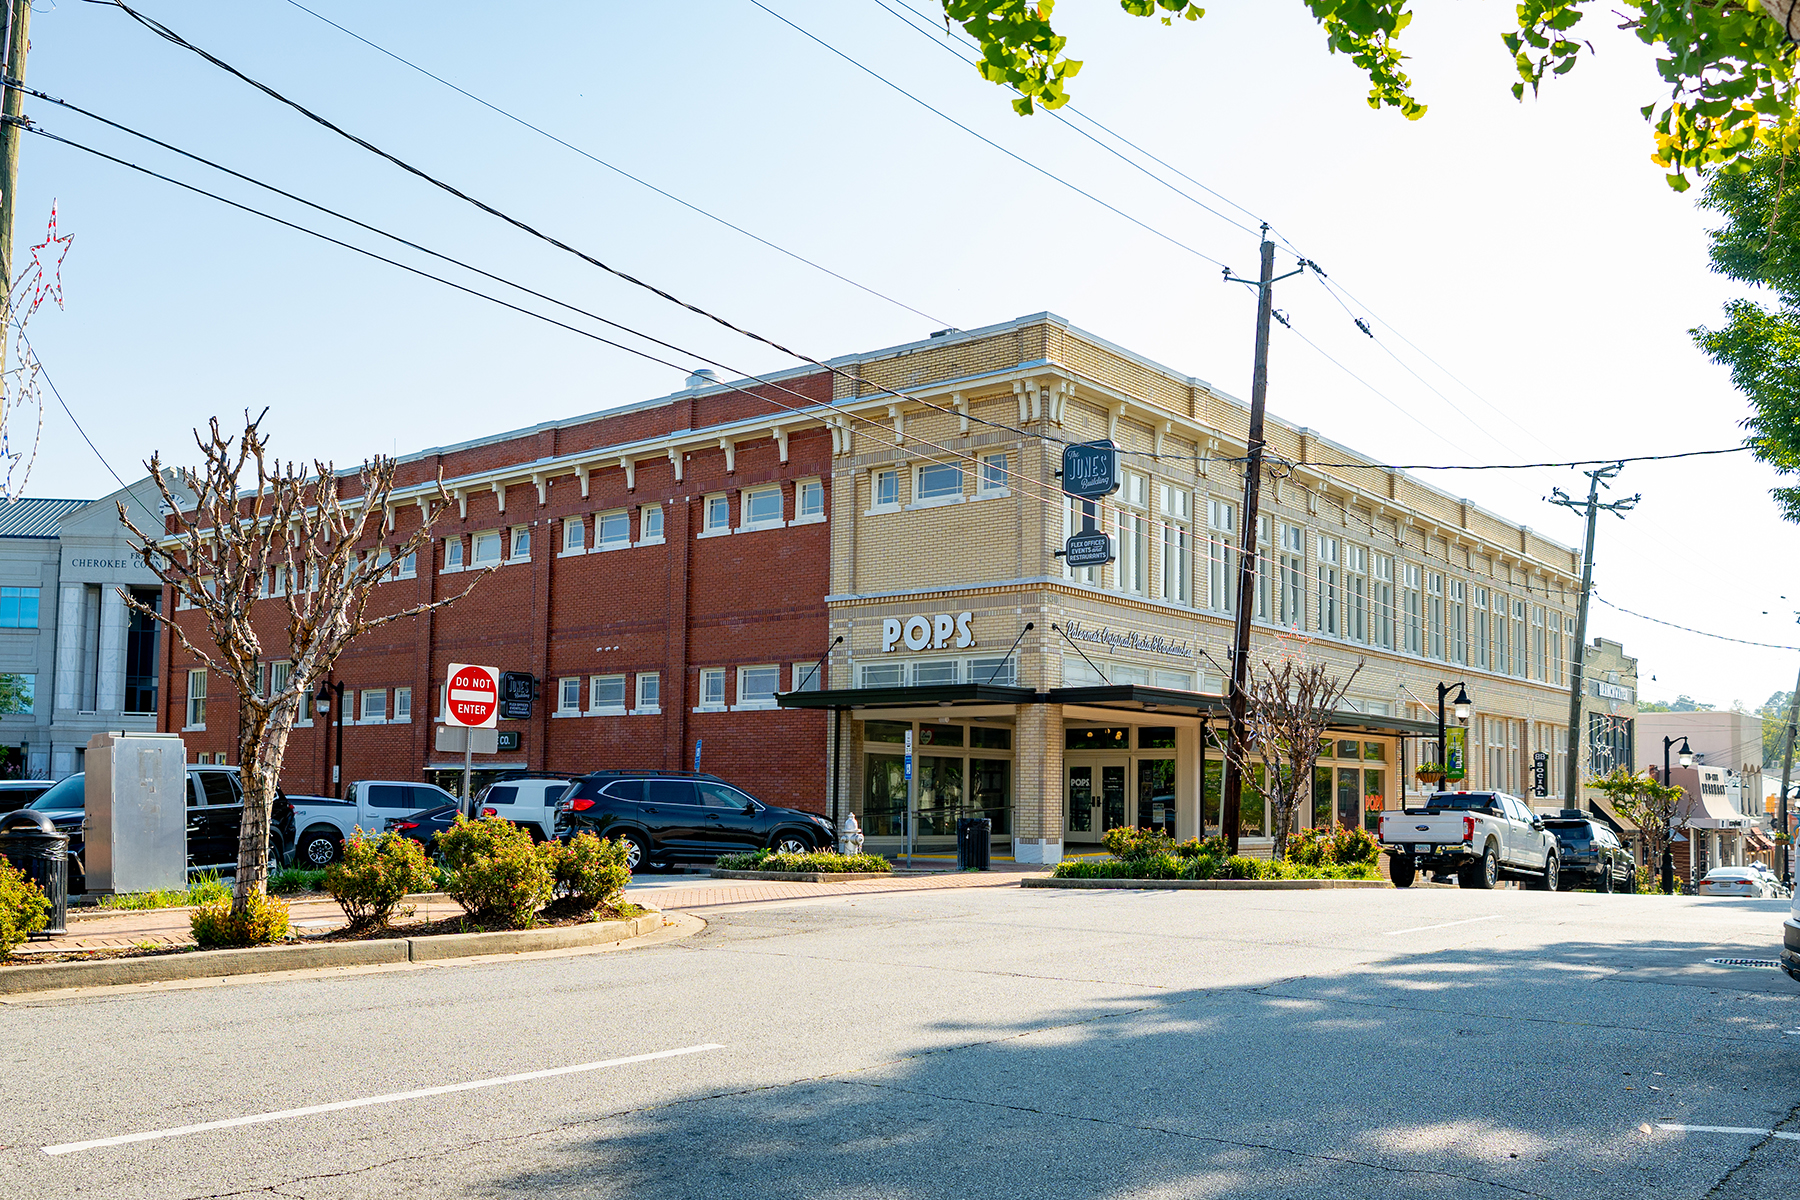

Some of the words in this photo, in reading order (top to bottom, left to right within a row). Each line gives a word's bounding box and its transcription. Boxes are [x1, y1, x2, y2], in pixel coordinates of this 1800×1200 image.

[1069, 454, 1107, 480] JONES
[1081, 477, 1109, 489] Building
[1083, 539, 1105, 547] OFFICES
[1069, 552, 1107, 561] RESTAURANTS
[71, 558, 127, 569] CHEROKEE
[456, 677, 469, 687] DO
[473, 679, 491, 688] NOT
[457, 704, 487, 715] ENTER
[1536, 761, 1545, 796] SOCIAL
